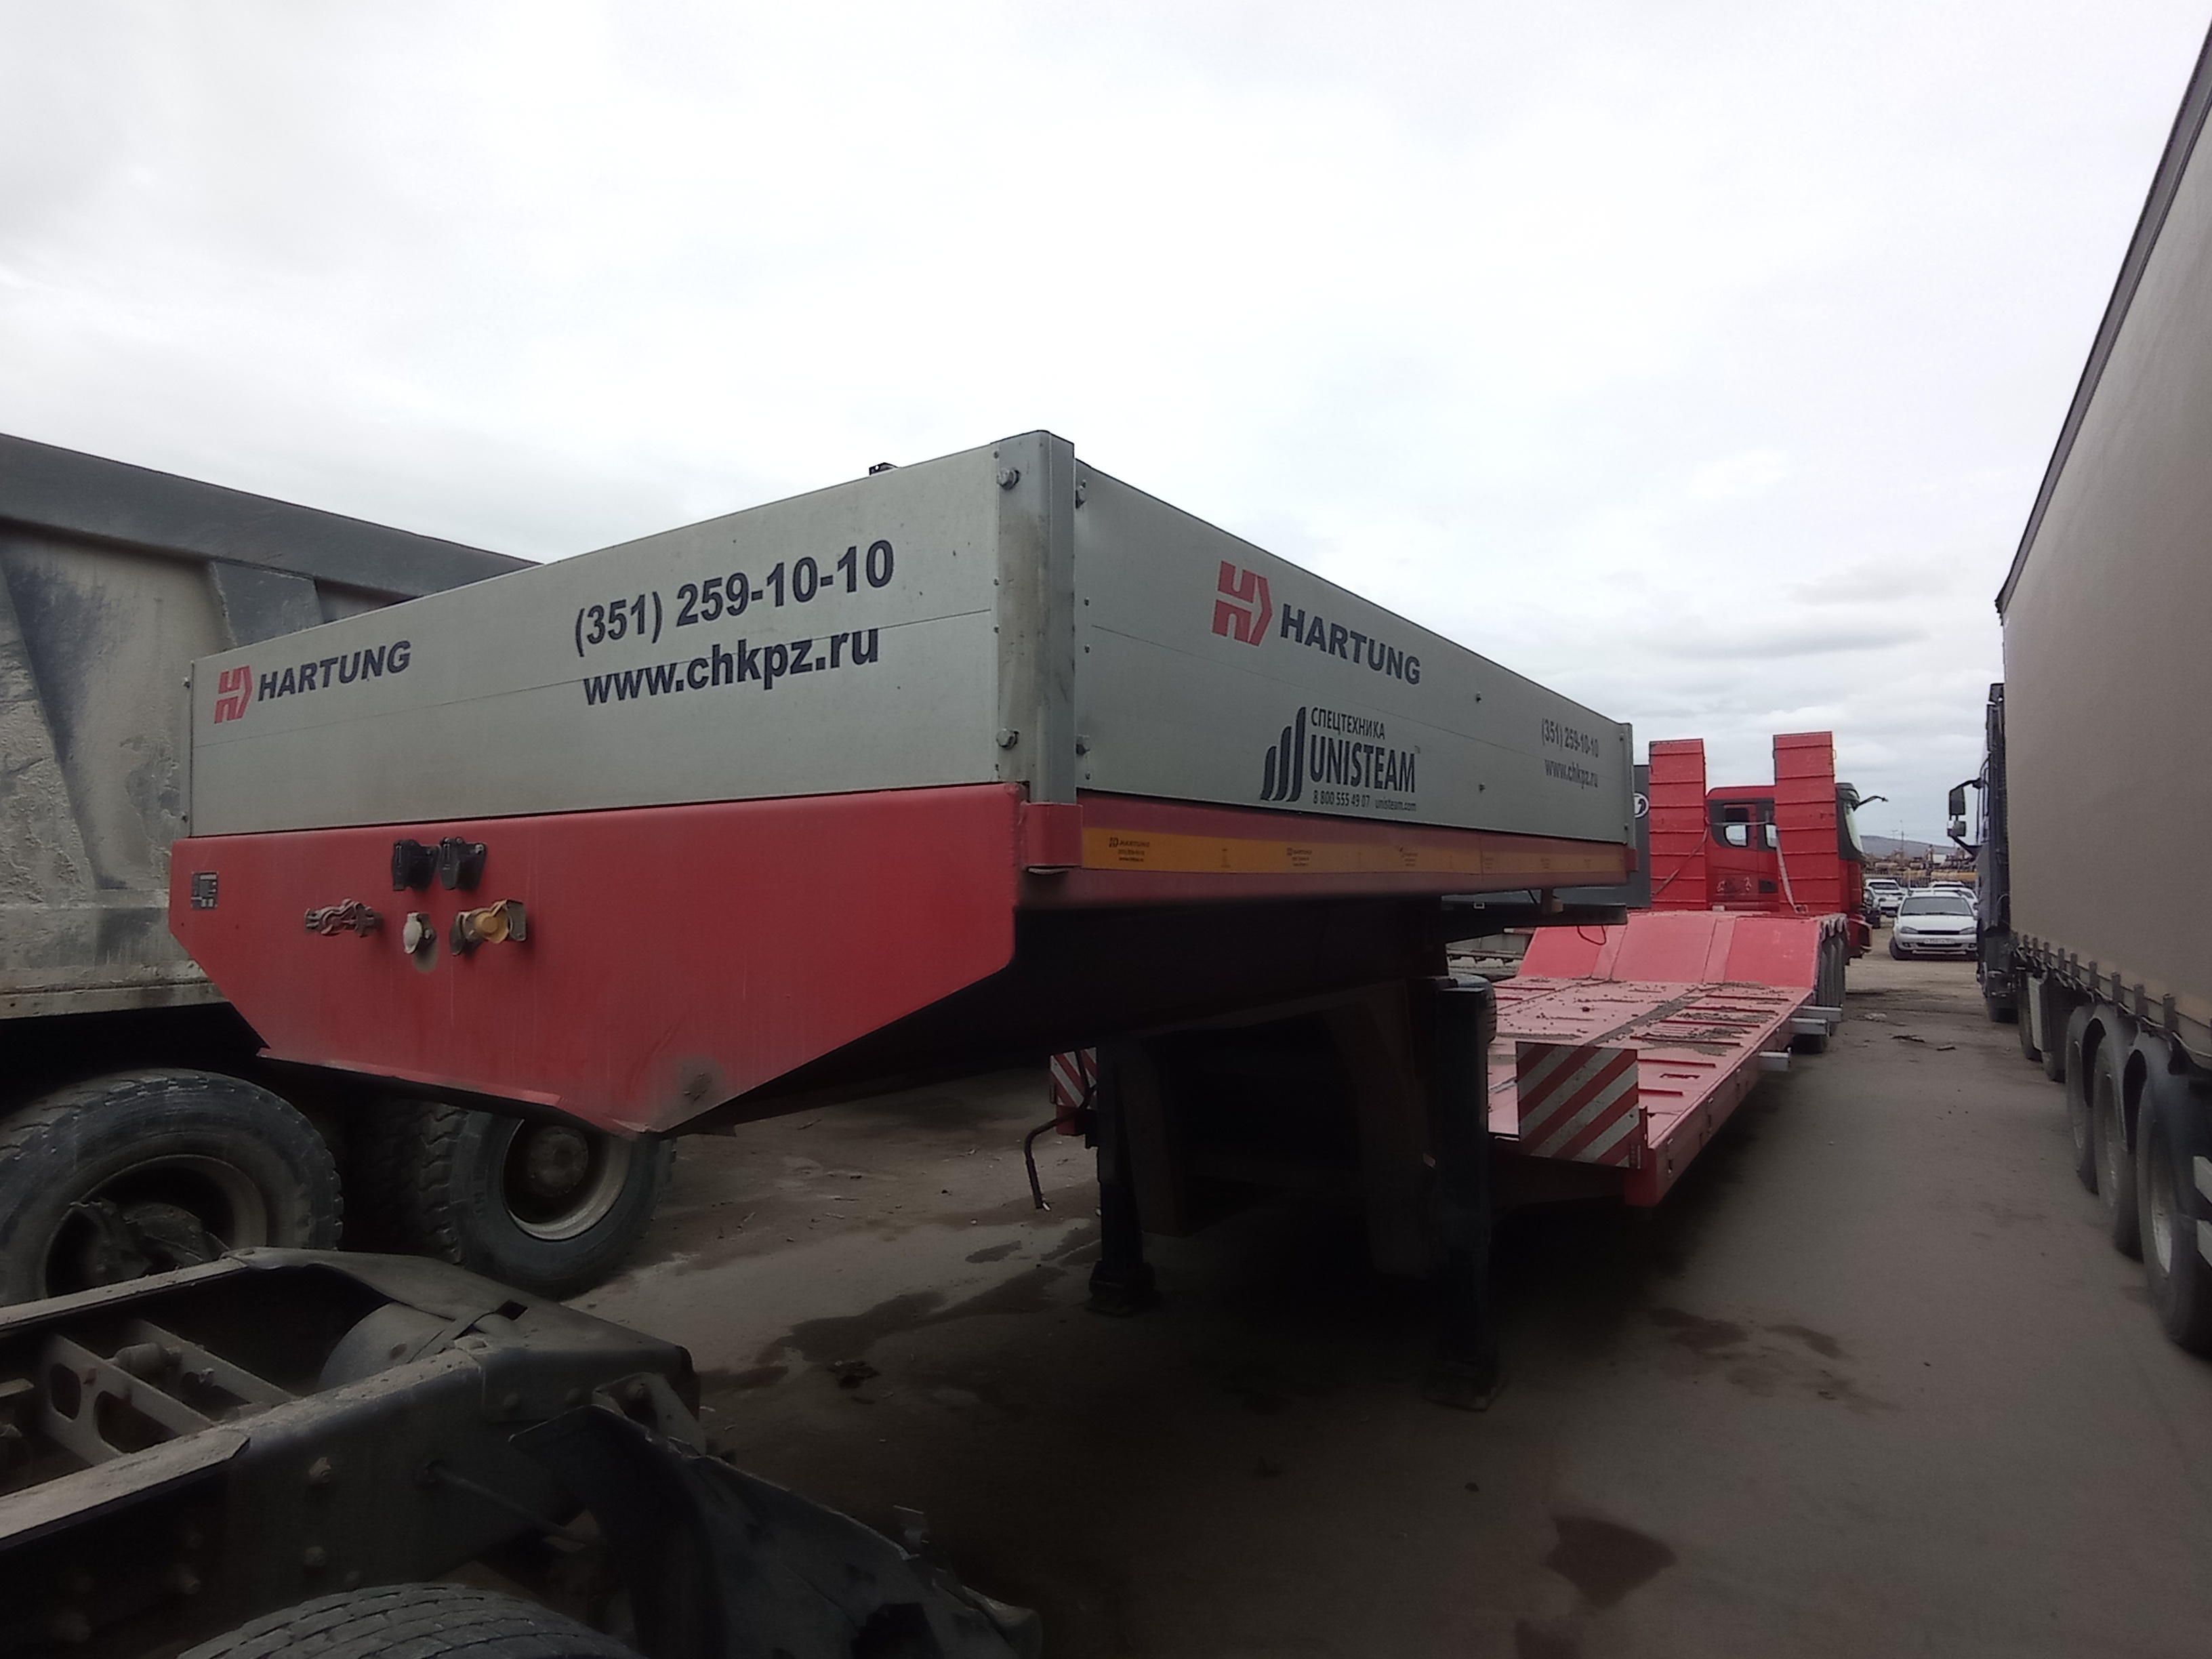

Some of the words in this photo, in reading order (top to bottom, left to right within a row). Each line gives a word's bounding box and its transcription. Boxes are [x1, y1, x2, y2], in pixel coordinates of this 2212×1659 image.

[575, 590, 662, 657] (351)
[676, 539, 894, 627] 259-10-10
[258, 640, 411, 702] HARTUNG
[583, 628, 879, 705] www.chkpz.ru
[1280, 602, 1421, 686] HARTUNG
[1311, 707, 1386, 740] СПЕЦТЕХНИКА
[1542, 718, 1563, 751] (351)
[1309, 734, 1416, 794] UNISTEAM
[1313, 790, 1318, 804] 8
[1320, 790, 1334, 805] 800
[1336, 792, 1349, 806] 555
